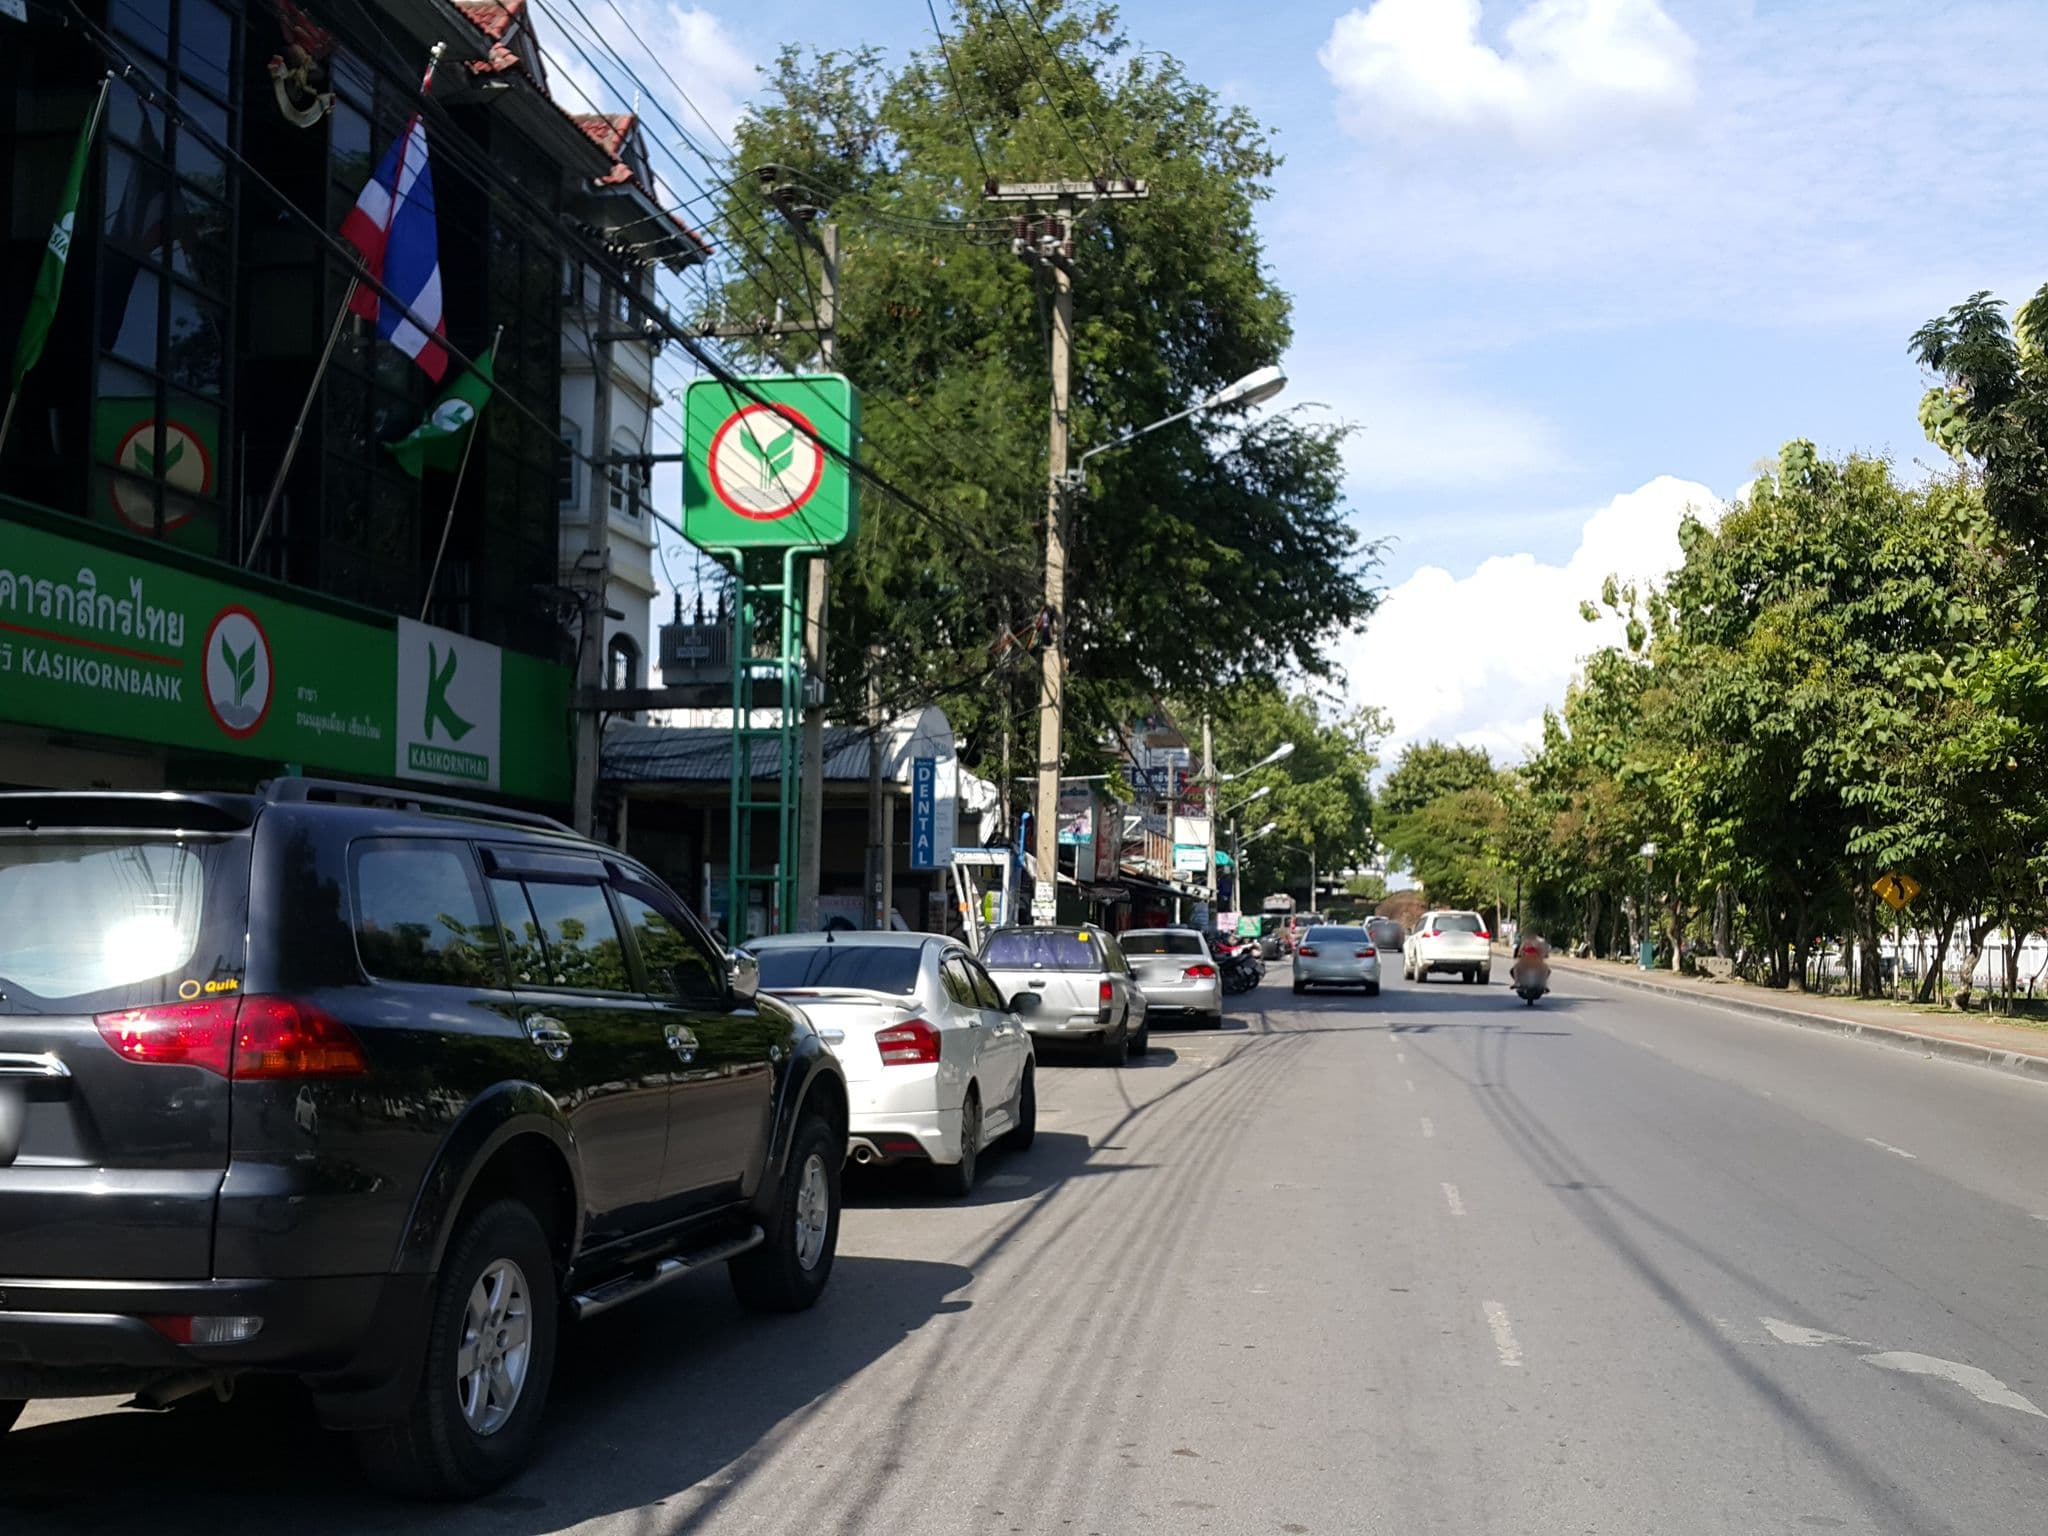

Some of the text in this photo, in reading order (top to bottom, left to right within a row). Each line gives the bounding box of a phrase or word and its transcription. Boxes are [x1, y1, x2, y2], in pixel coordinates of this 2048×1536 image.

[22, 647, 183, 702] KASIKORNBANK
[411, 747, 487, 778] KASIKORNTHAI
[917, 767, 931, 865] DENTAL
[204, 978, 239, 993] Quik
